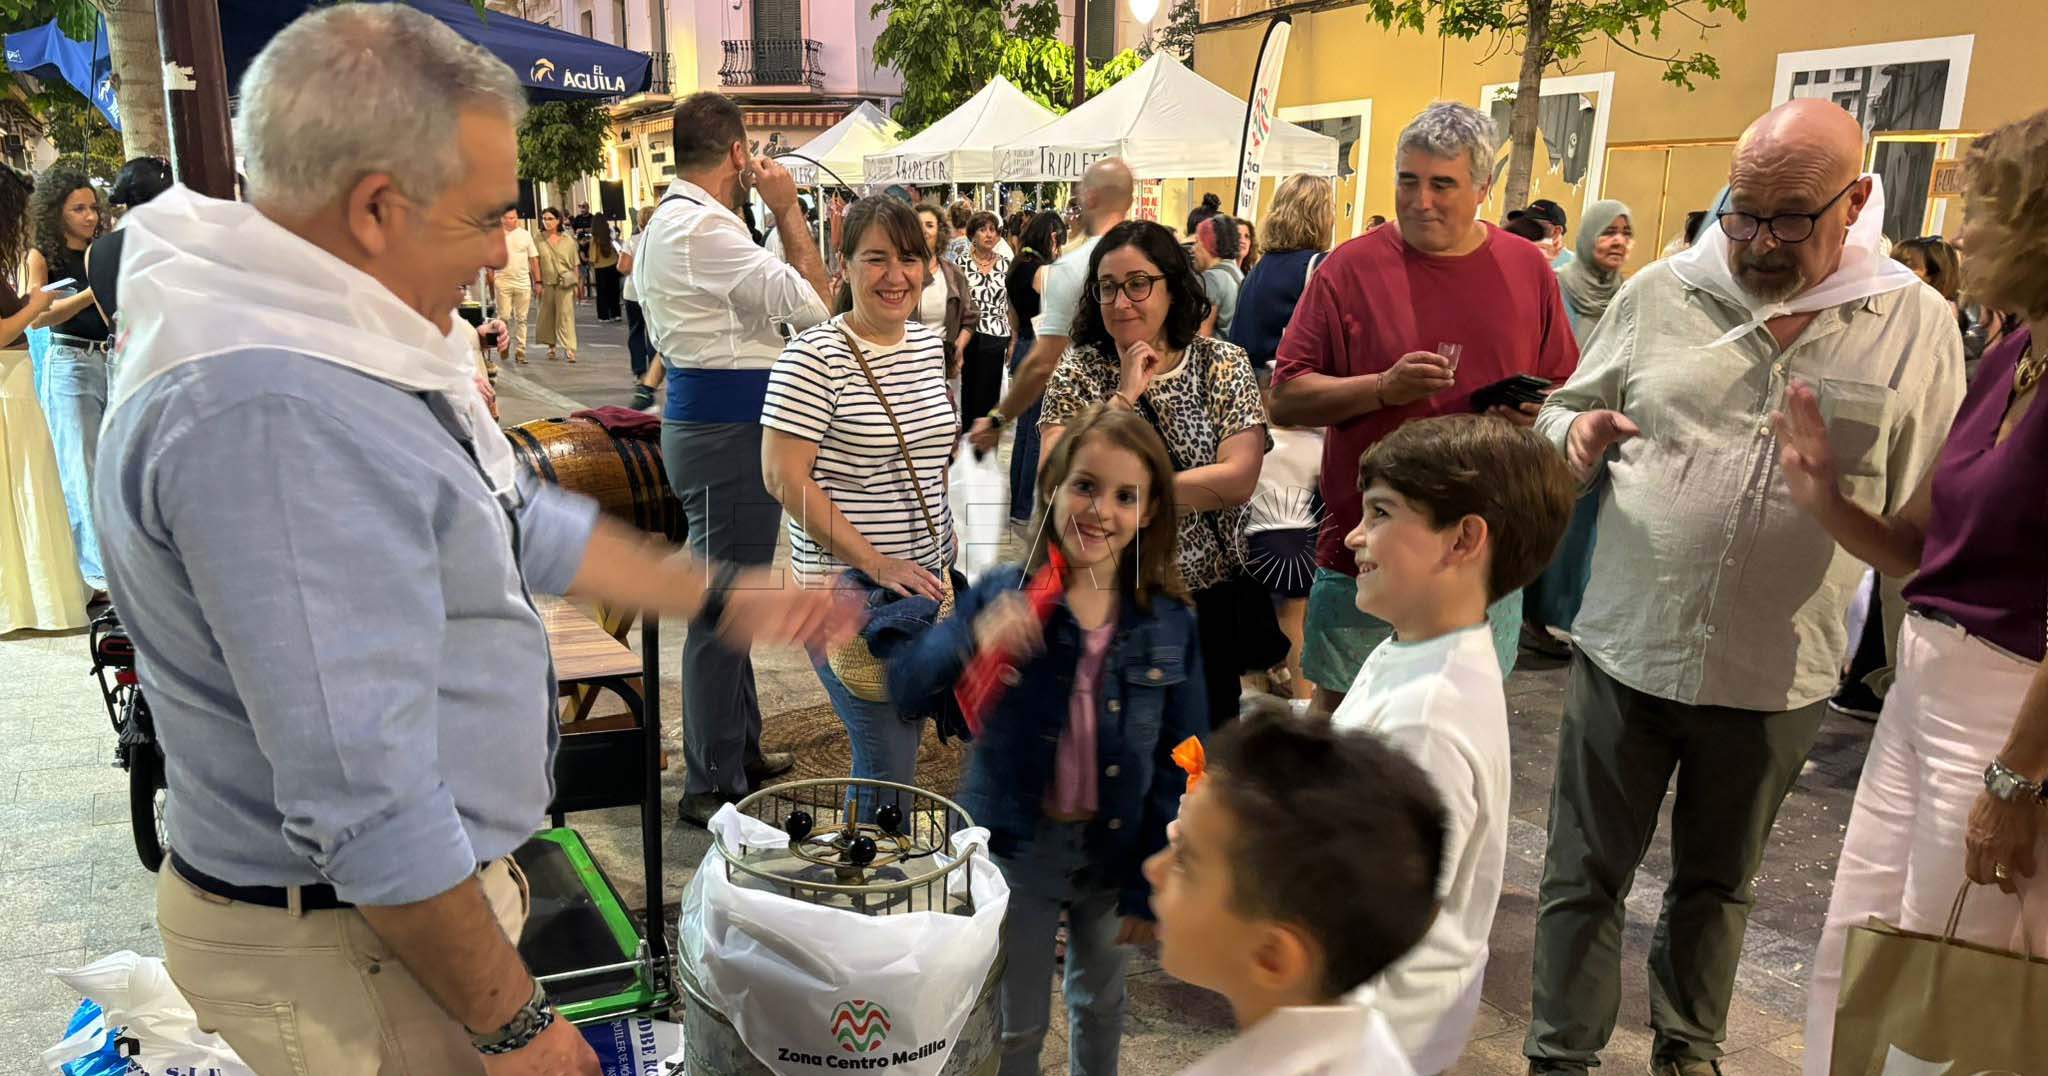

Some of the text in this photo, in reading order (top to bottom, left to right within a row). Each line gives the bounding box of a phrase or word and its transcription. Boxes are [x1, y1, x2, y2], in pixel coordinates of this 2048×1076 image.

[563, 68, 626, 92] ÁGUILA
[593, 64, 604, 75] EL
[895, 154, 947, 181] TRIPLETA
[777, 1038, 947, 1069] Zona Centro Melilla
